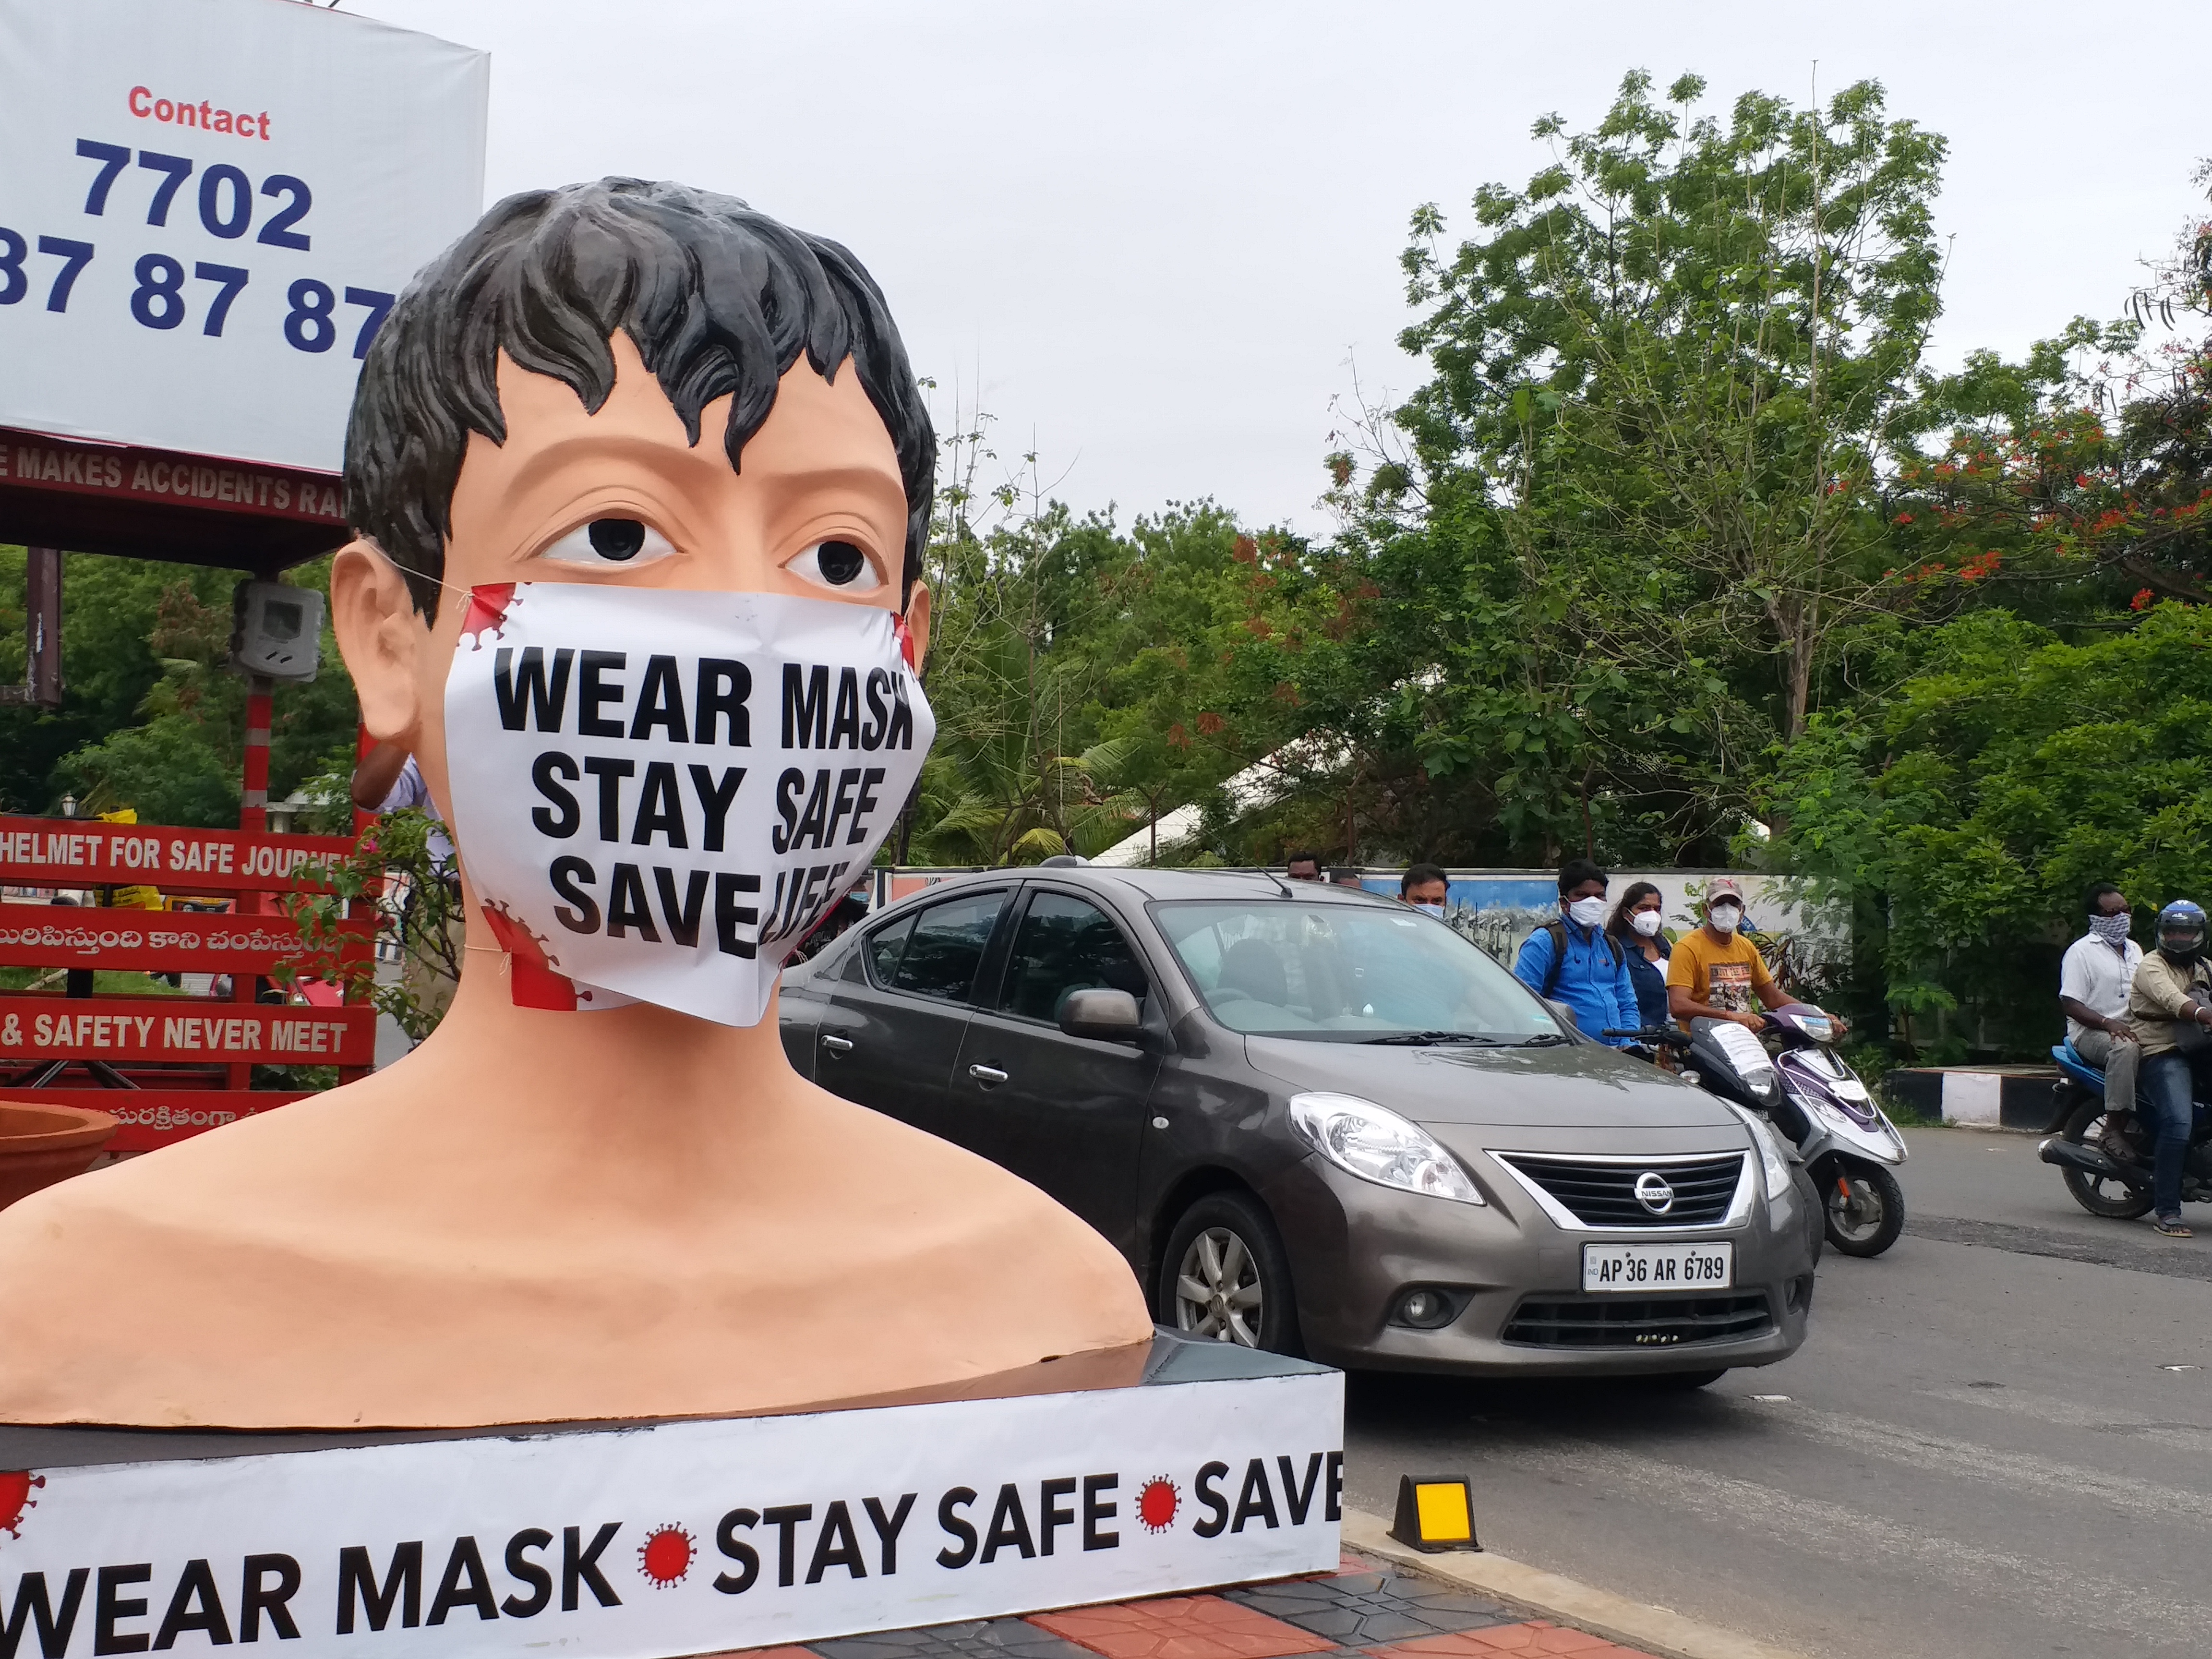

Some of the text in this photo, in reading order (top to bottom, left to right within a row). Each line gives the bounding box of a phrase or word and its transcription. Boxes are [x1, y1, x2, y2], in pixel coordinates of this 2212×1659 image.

[129, 85, 271, 141] Contact
[76, 138, 313, 251] 7702
[130, 253, 249, 337] 87
[284, 278, 396, 359] 87
[17, 446, 121, 488] MAKES
[131, 459, 290, 510] ACCIDENTS
[299, 482, 347, 519] RA
[494, 647, 913, 751] WEAR MASK
[0, 831, 103, 866] HELMET
[110, 836, 160, 869] FOR
[169, 840, 235, 874] SAFE
[531, 751, 886, 855] STAY SAFE
[549, 855, 761, 959] SAVE
[1, 1013, 348, 1053] & SAFETY NEVER MEET
[1599, 1256, 1724, 1282] AP 36 AR 6789
[0, 1551, 301, 1659] WEAR
[336, 1521, 623, 1635] MASK
[713, 1492, 918, 1595] STAY
[935, 1472, 1119, 1570] SAFE
